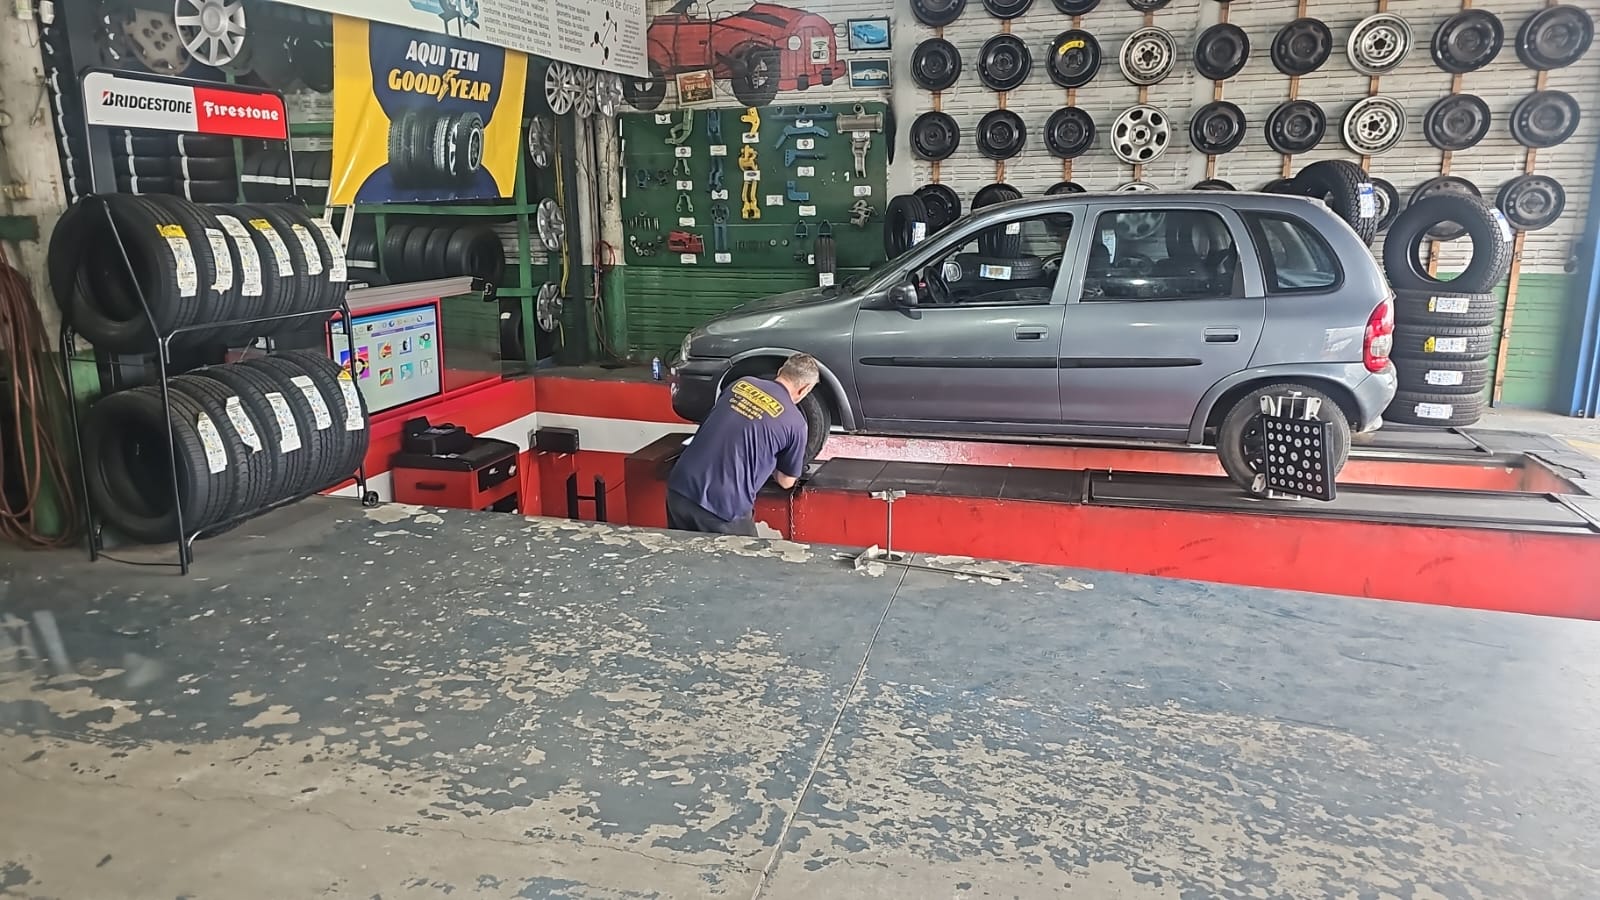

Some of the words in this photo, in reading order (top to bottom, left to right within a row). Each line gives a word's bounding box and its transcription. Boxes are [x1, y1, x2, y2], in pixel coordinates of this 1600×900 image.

[405, 40, 446, 67] AQUI
[449, 48, 479, 71] TEM
[388, 68, 491, 102] GOODYEAR
[102, 91, 192, 114] BRIDGESTONE
[203, 101, 279, 121] Firestone
